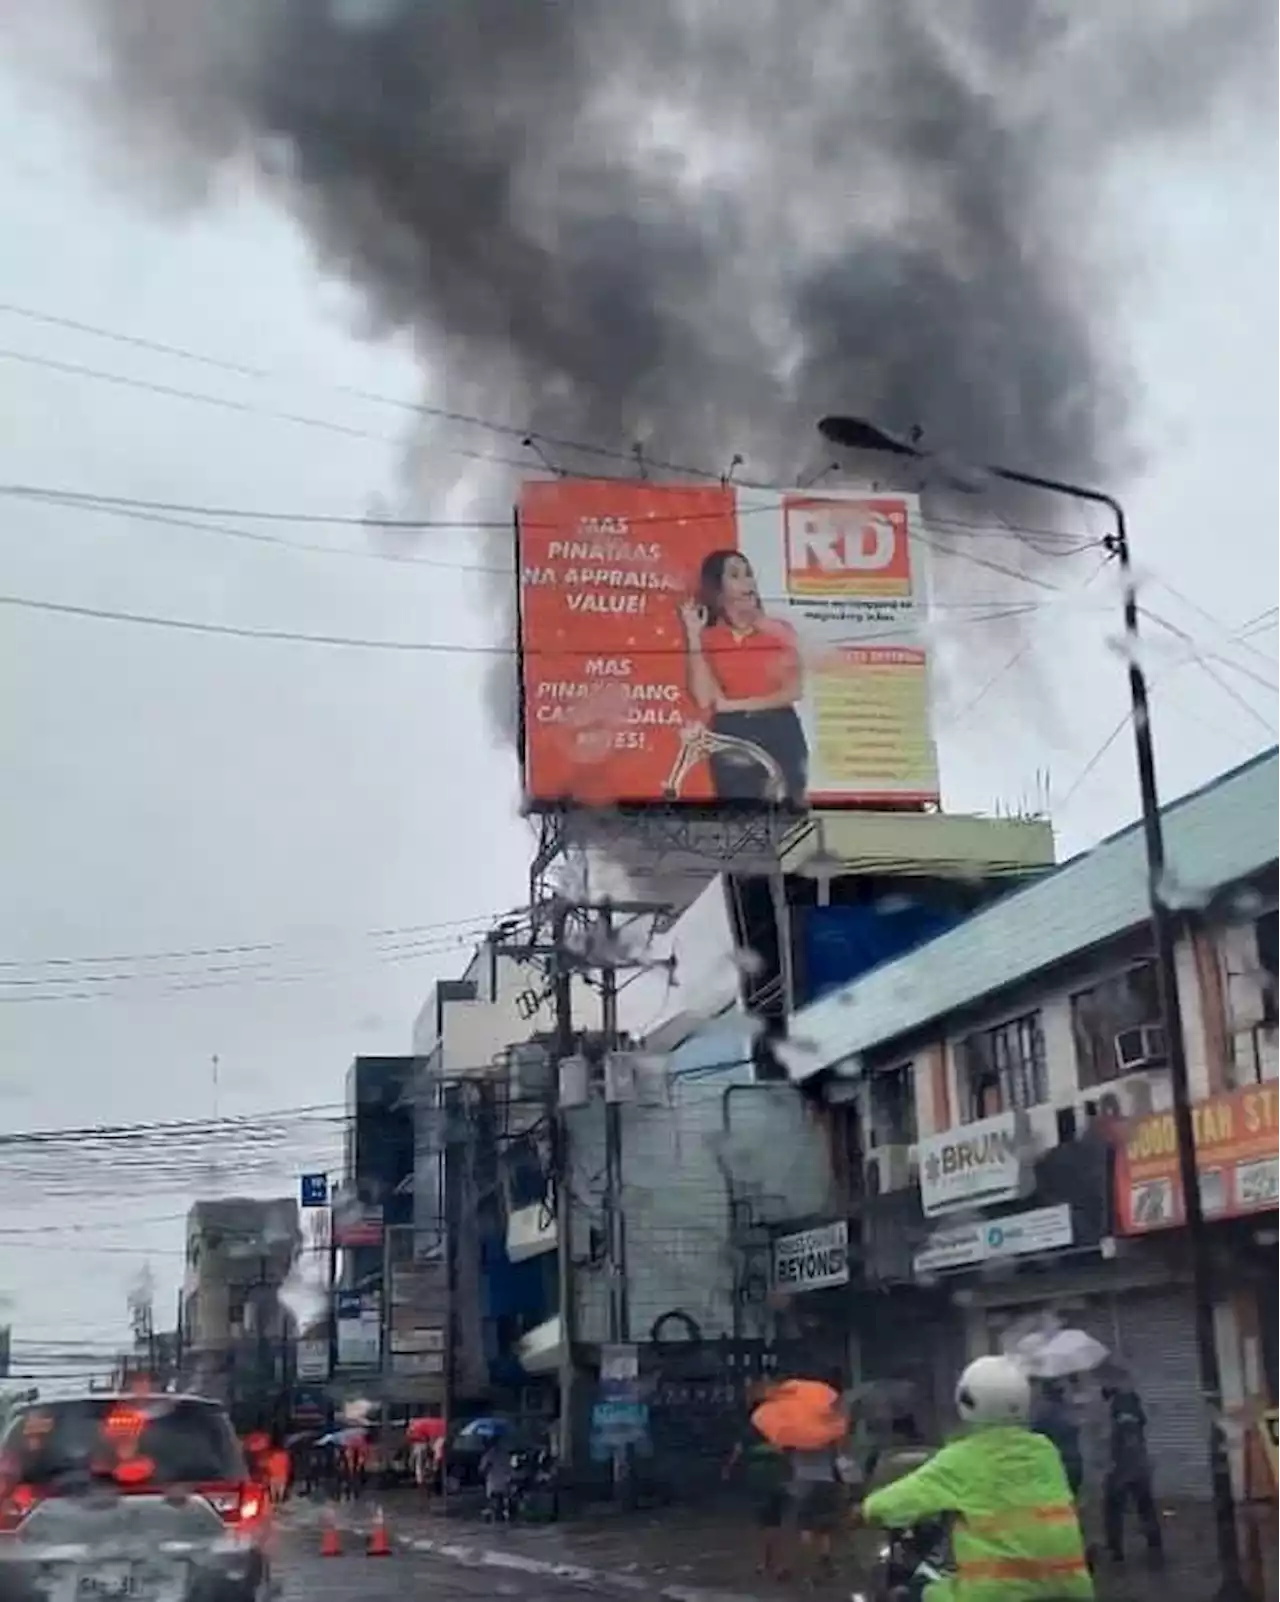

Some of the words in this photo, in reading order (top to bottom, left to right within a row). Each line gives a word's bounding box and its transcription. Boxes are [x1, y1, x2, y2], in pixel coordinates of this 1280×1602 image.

[788, 507, 895, 573] RD
[566, 593, 646, 613] VALUE!
[585, 658, 633, 676] MAS
[612, 707, 683, 724] DALA
[577, 731, 645, 749] ES!
